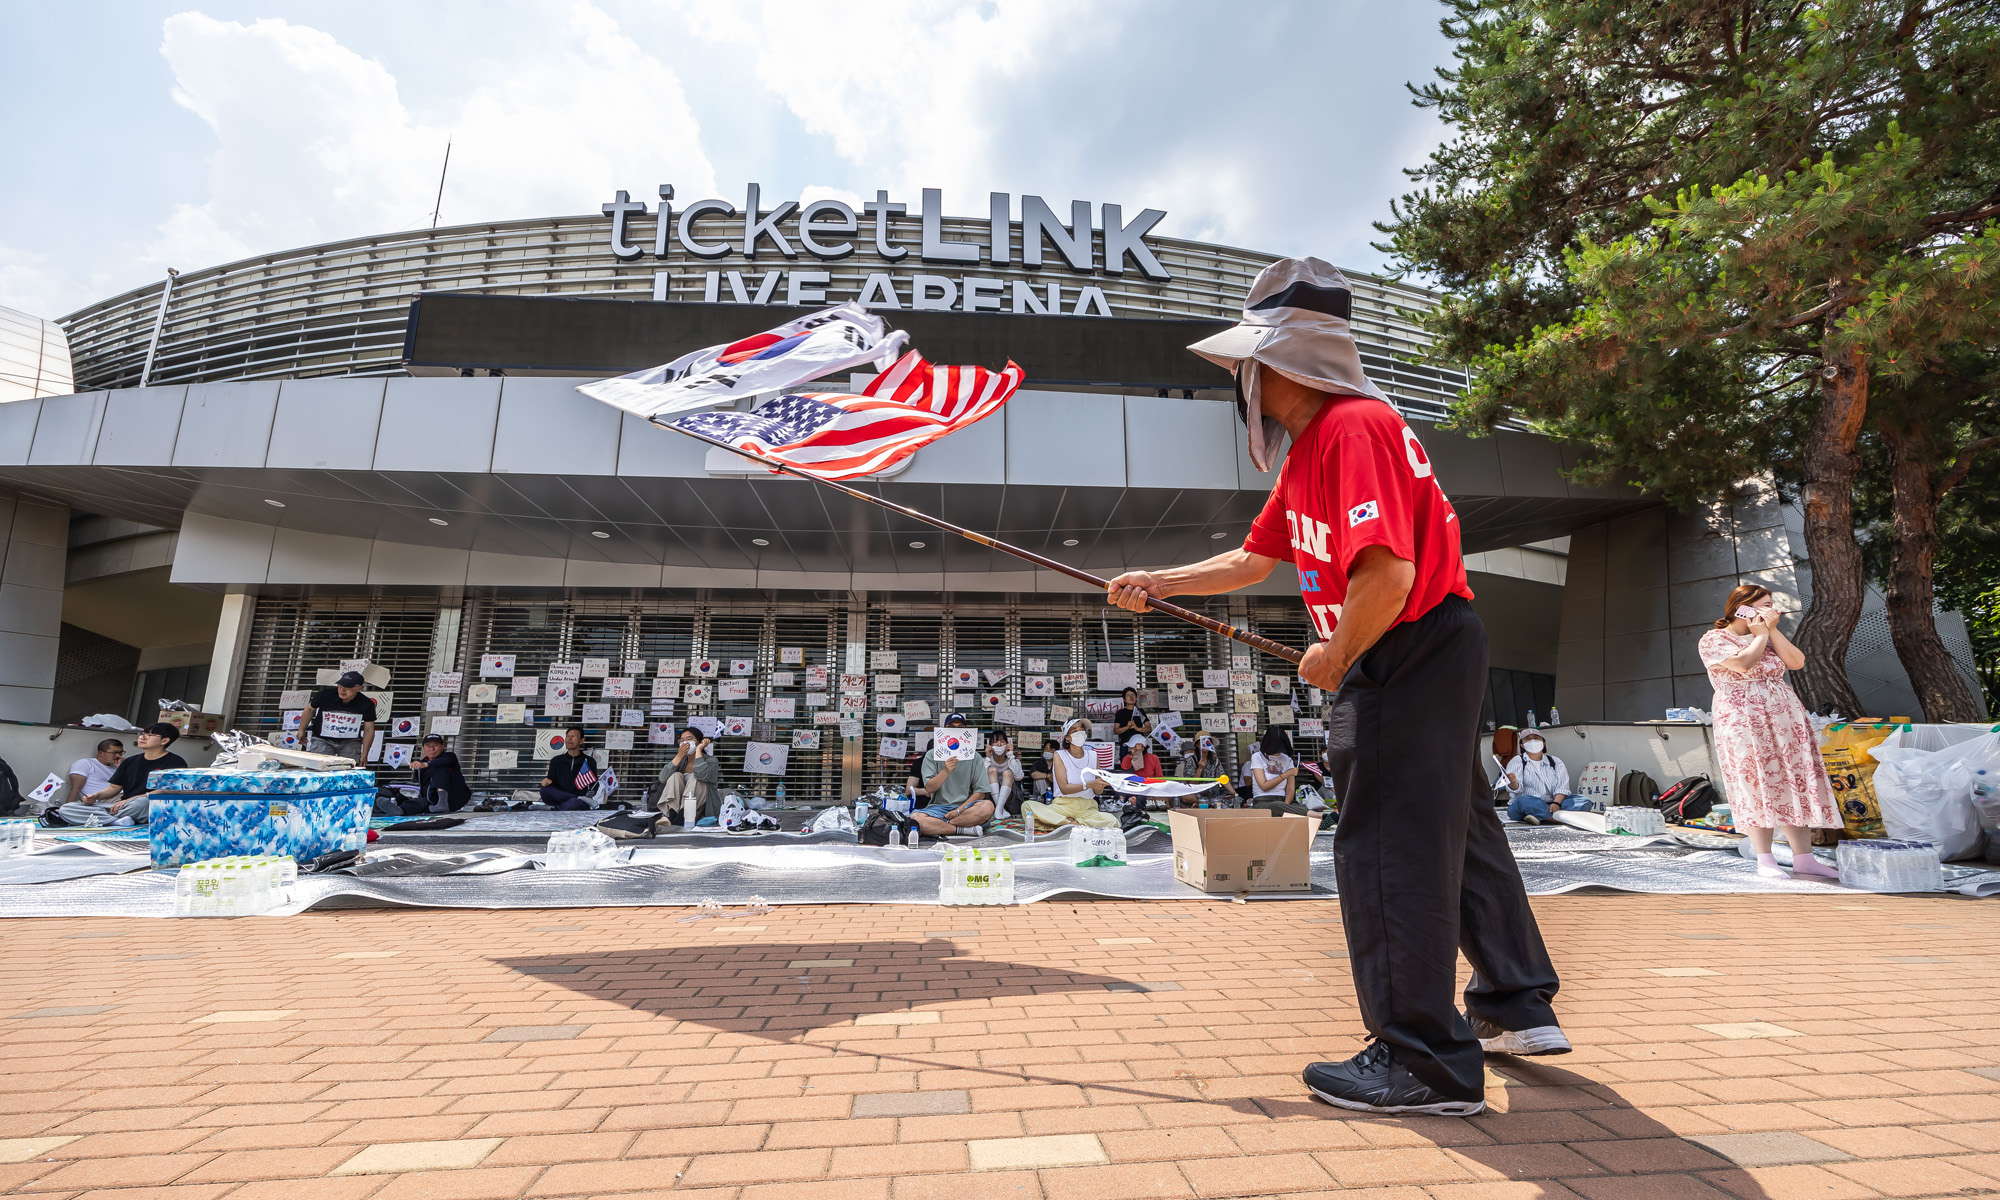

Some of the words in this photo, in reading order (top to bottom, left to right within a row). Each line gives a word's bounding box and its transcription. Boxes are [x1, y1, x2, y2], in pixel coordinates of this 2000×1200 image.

[602, 182, 1171, 282] ticketLINK
[1158, 665, 1179, 675] 수개표
[841, 675, 866, 687] 재선거
[843, 697, 866, 709] 재선거
[196, 879, 219, 893] 풀무원
